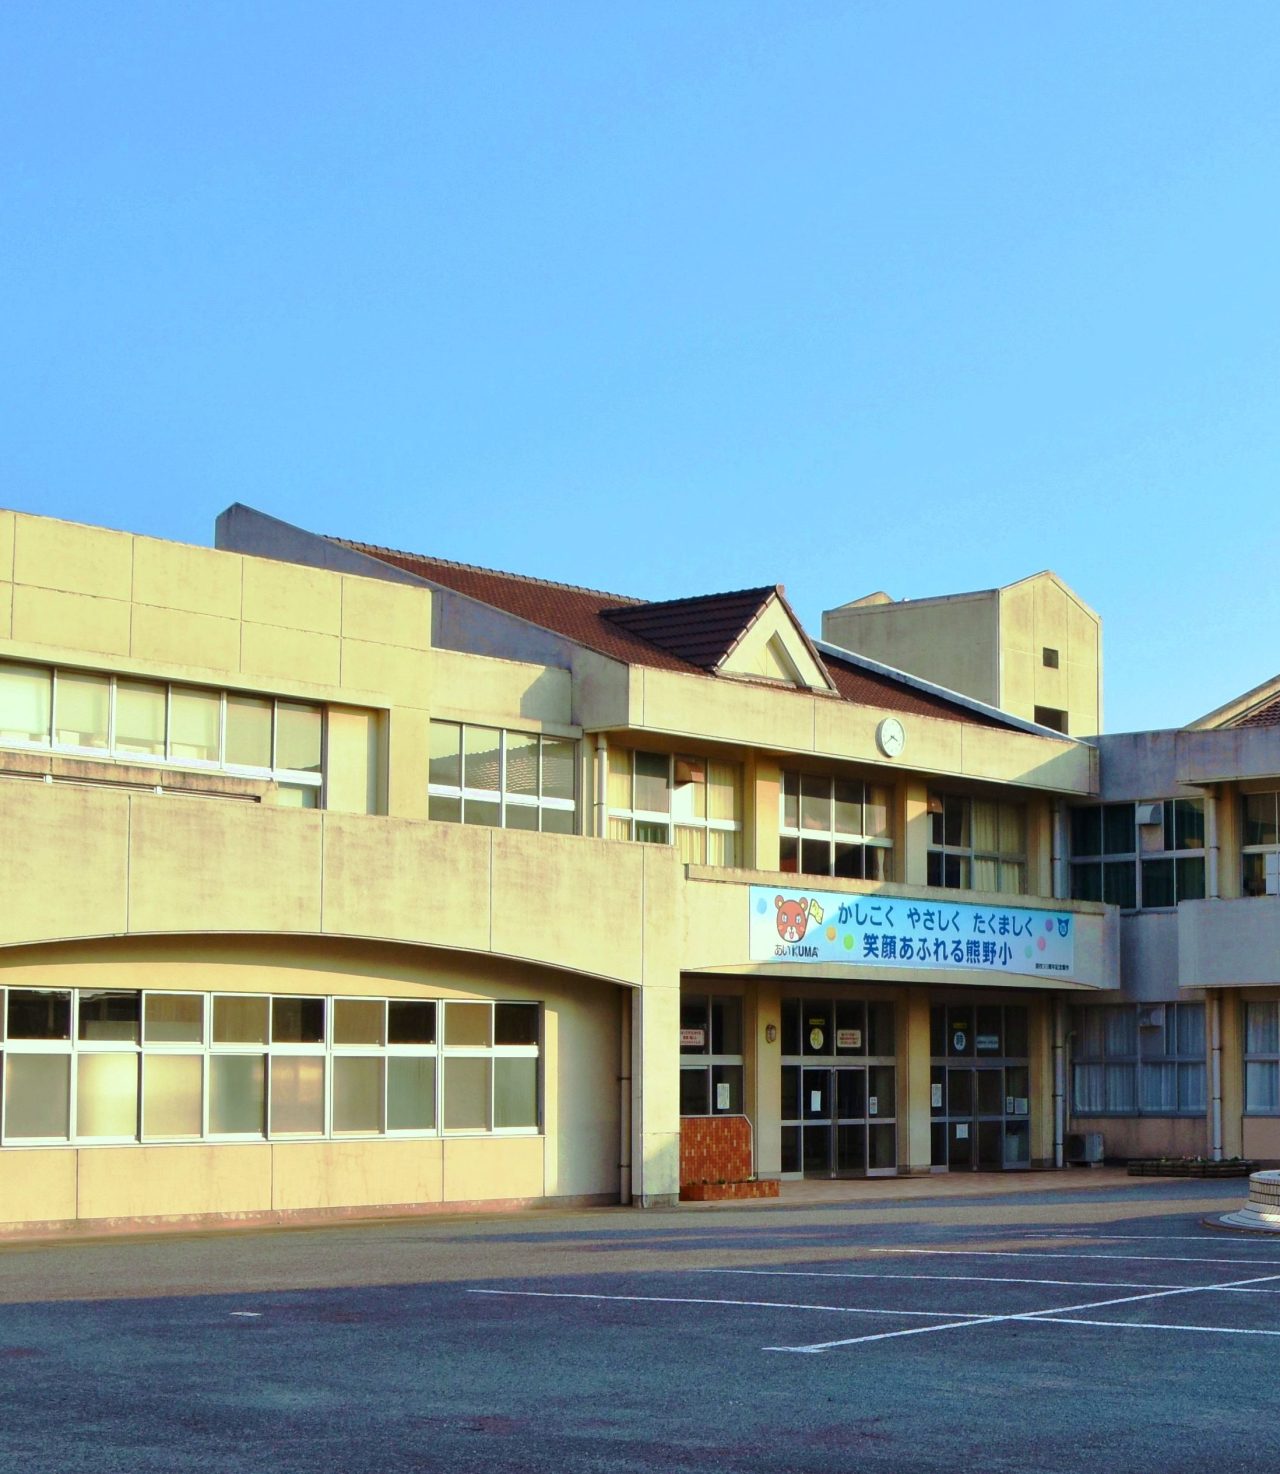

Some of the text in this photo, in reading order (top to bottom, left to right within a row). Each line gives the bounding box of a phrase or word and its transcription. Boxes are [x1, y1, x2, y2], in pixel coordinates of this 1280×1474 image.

[838, 901, 1033, 937] かしこく やさしく たくましく
[774, 944, 819, 958] あいKUMA
[863, 932, 1013, 966] 笑顔あふれる熊野小
